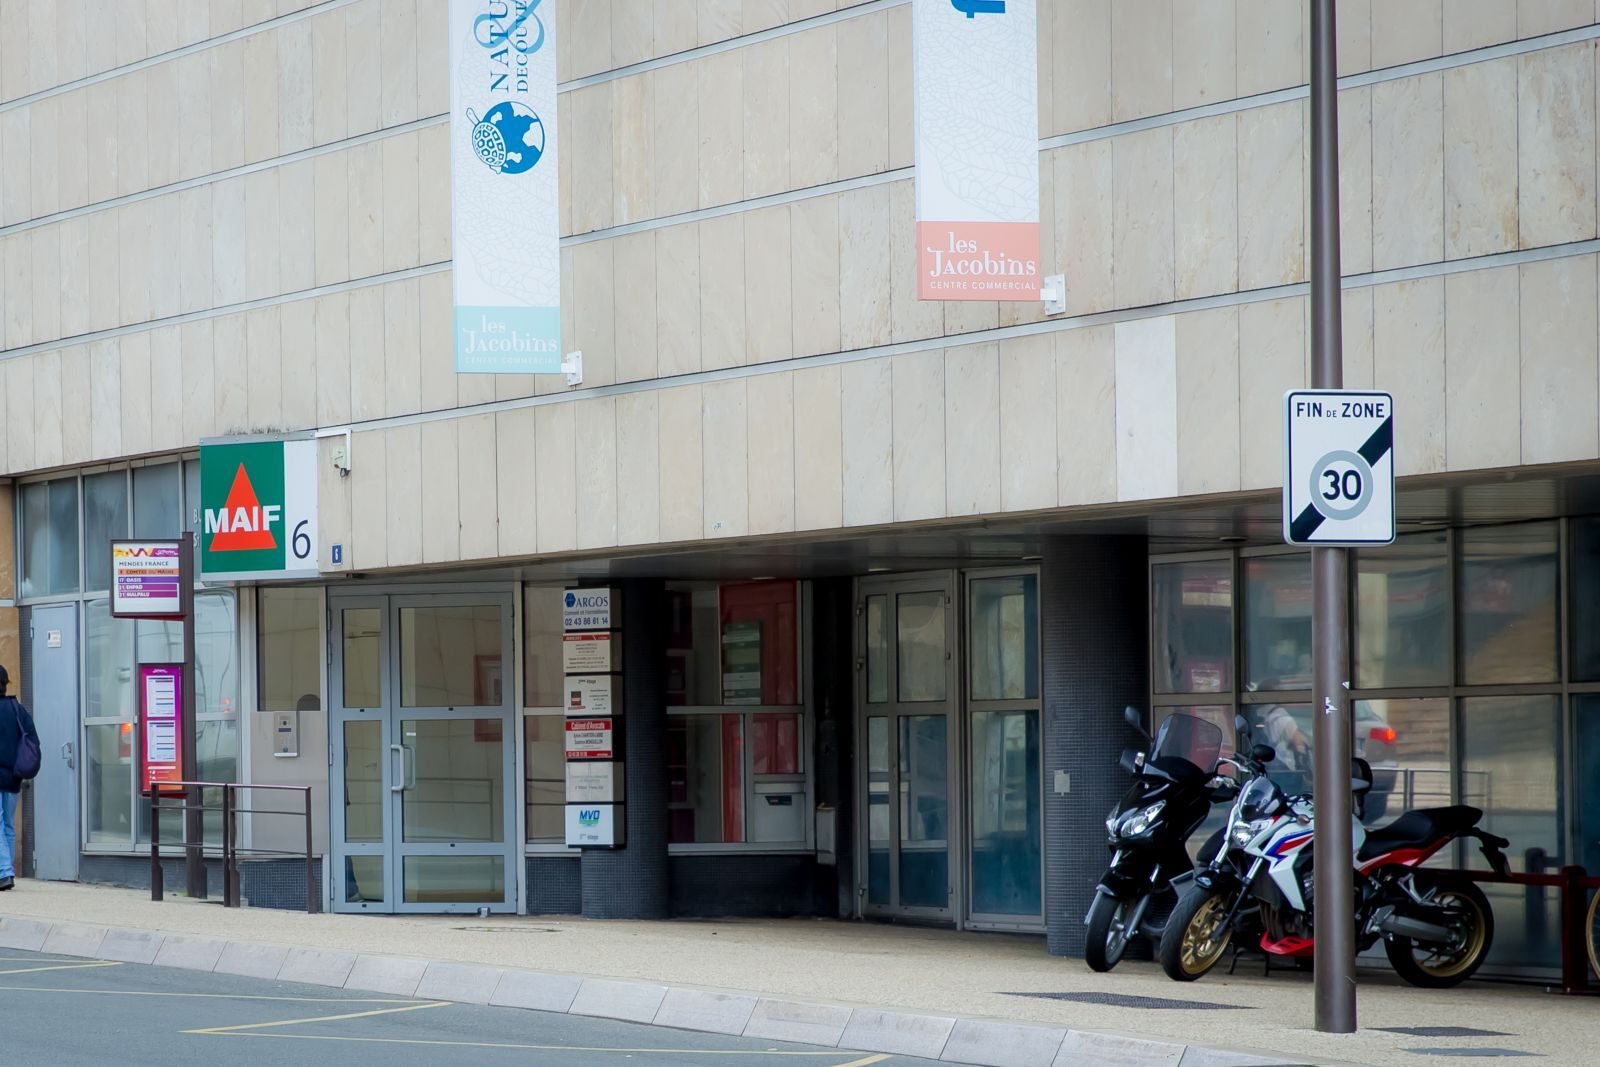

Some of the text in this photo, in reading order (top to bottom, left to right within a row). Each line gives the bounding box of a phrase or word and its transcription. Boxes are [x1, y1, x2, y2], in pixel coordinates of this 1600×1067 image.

[947, 231, 977, 254] les
[930, 281, 1036, 290] CENTRE COMMERCIAL
[480, 314, 507, 334] les
[1296, 402, 1385, 418] FIN DE ZONE
[1322, 469, 1362, 501] 30
[204, 505, 281, 534] MAIF
[292, 519, 311, 560] 6
[334, 547, 339, 561] 6
[575, 596, 609, 608] ARGOS
[564, 618, 573, 626] 02
[574, 617, 582, 626] 43
[601, 616, 609, 625] 14
